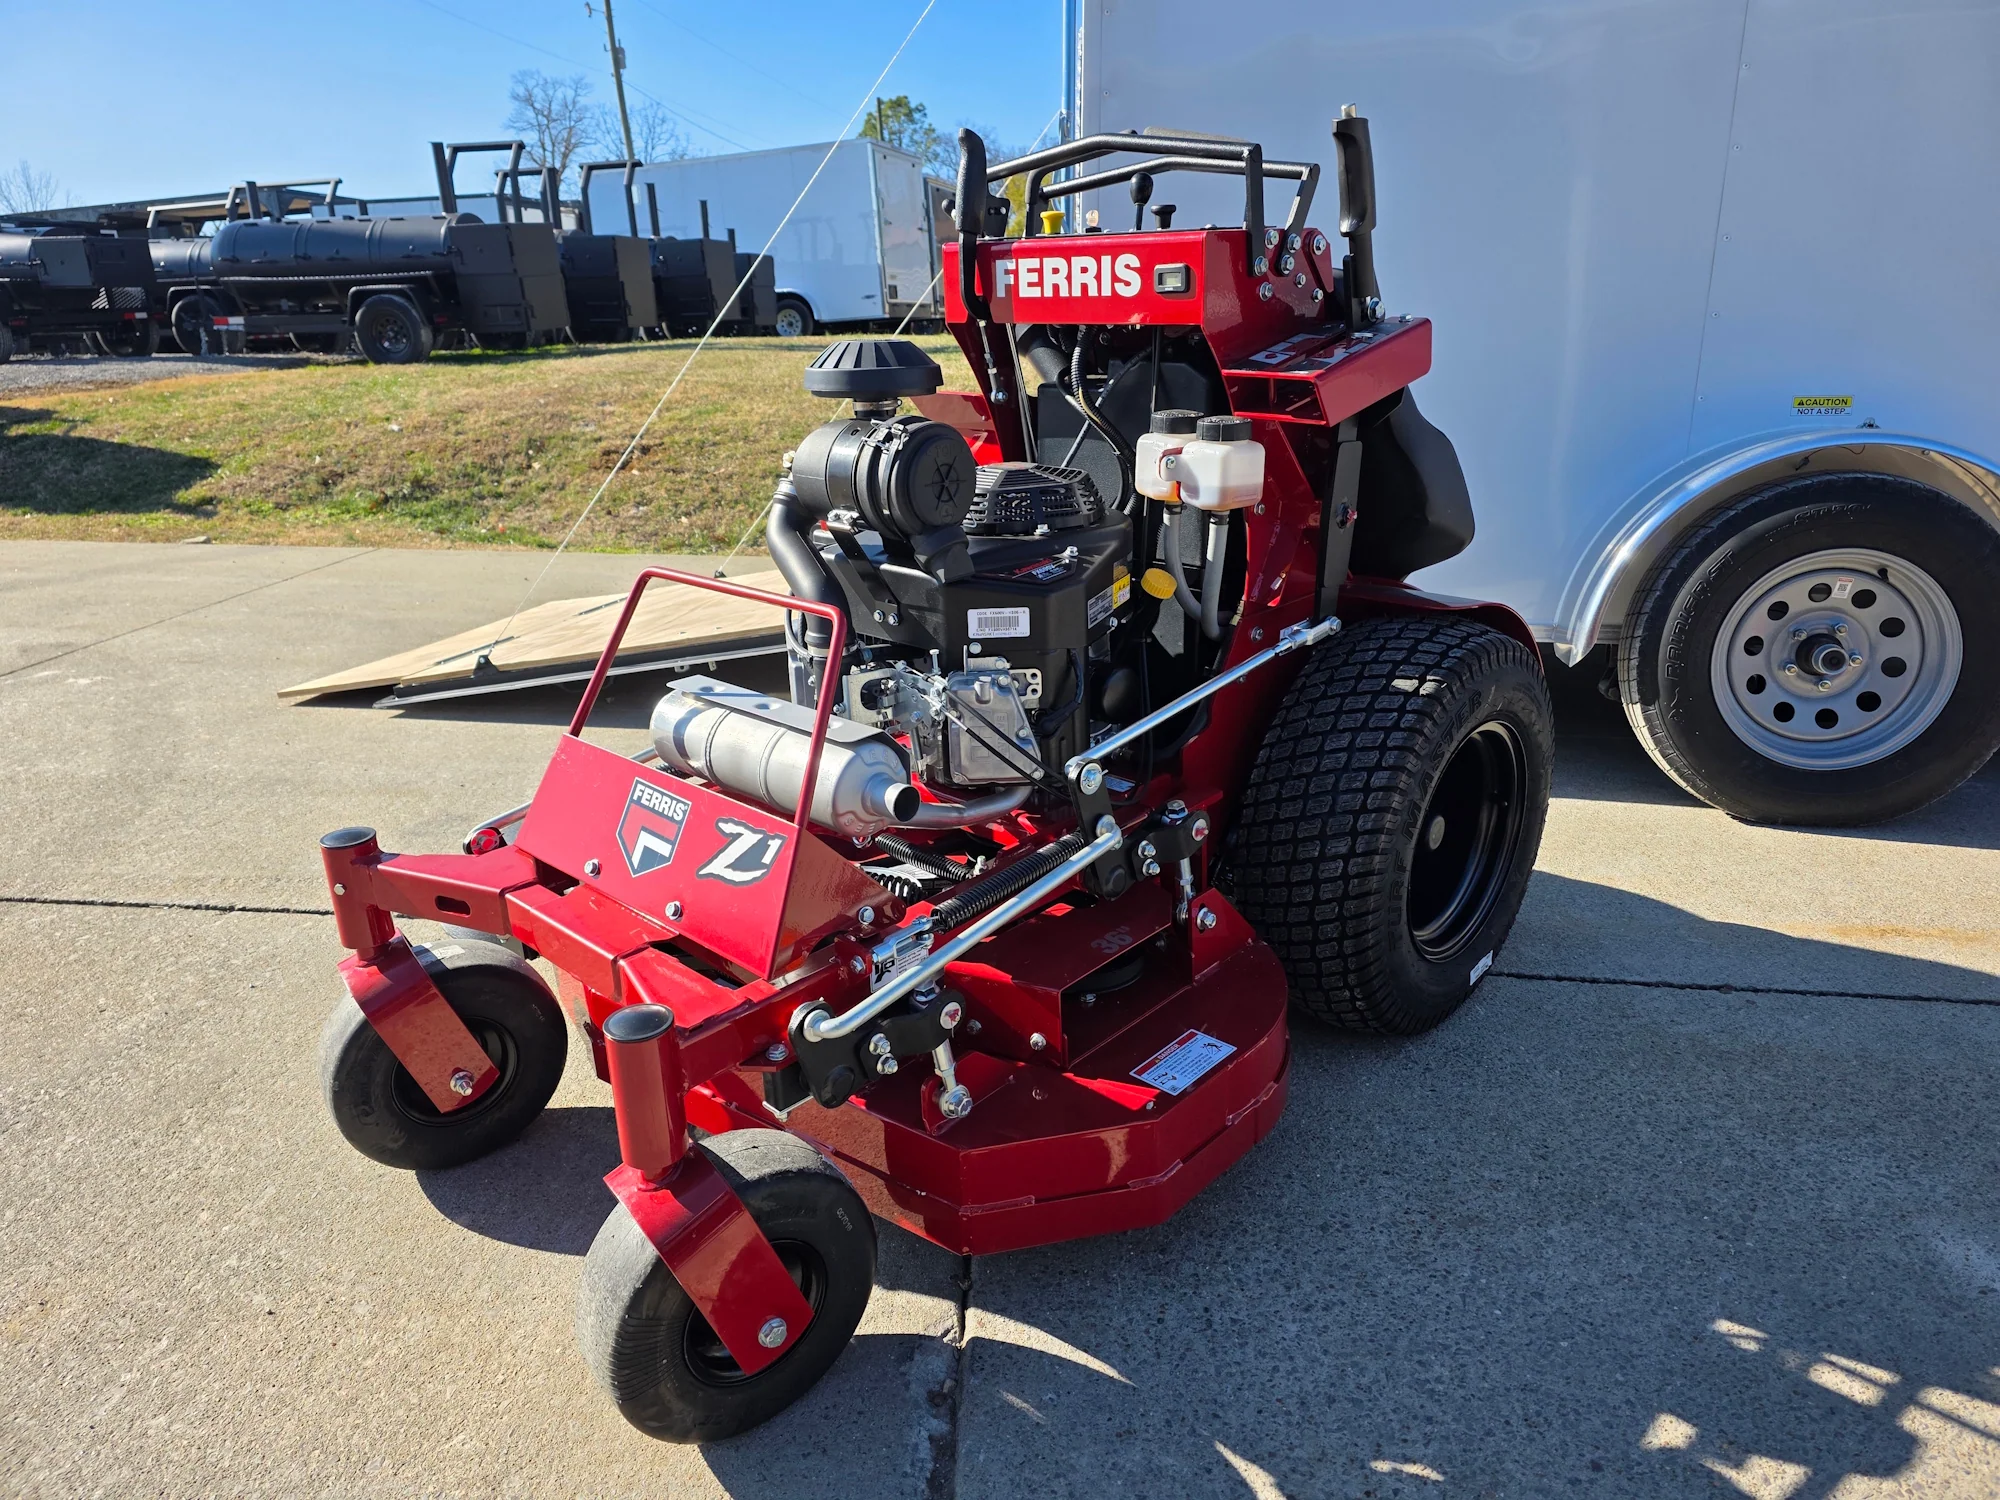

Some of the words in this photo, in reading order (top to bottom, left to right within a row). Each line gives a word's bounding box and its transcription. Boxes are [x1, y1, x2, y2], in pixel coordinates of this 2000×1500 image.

[995, 253, 1142, 298] FERRIS
[1805, 398, 1848, 406] CAUTION
[632, 782, 687, 822] FERRIS
[699, 822, 783, 882] Z1
[1157, 1043, 1181, 1061] DANGER
